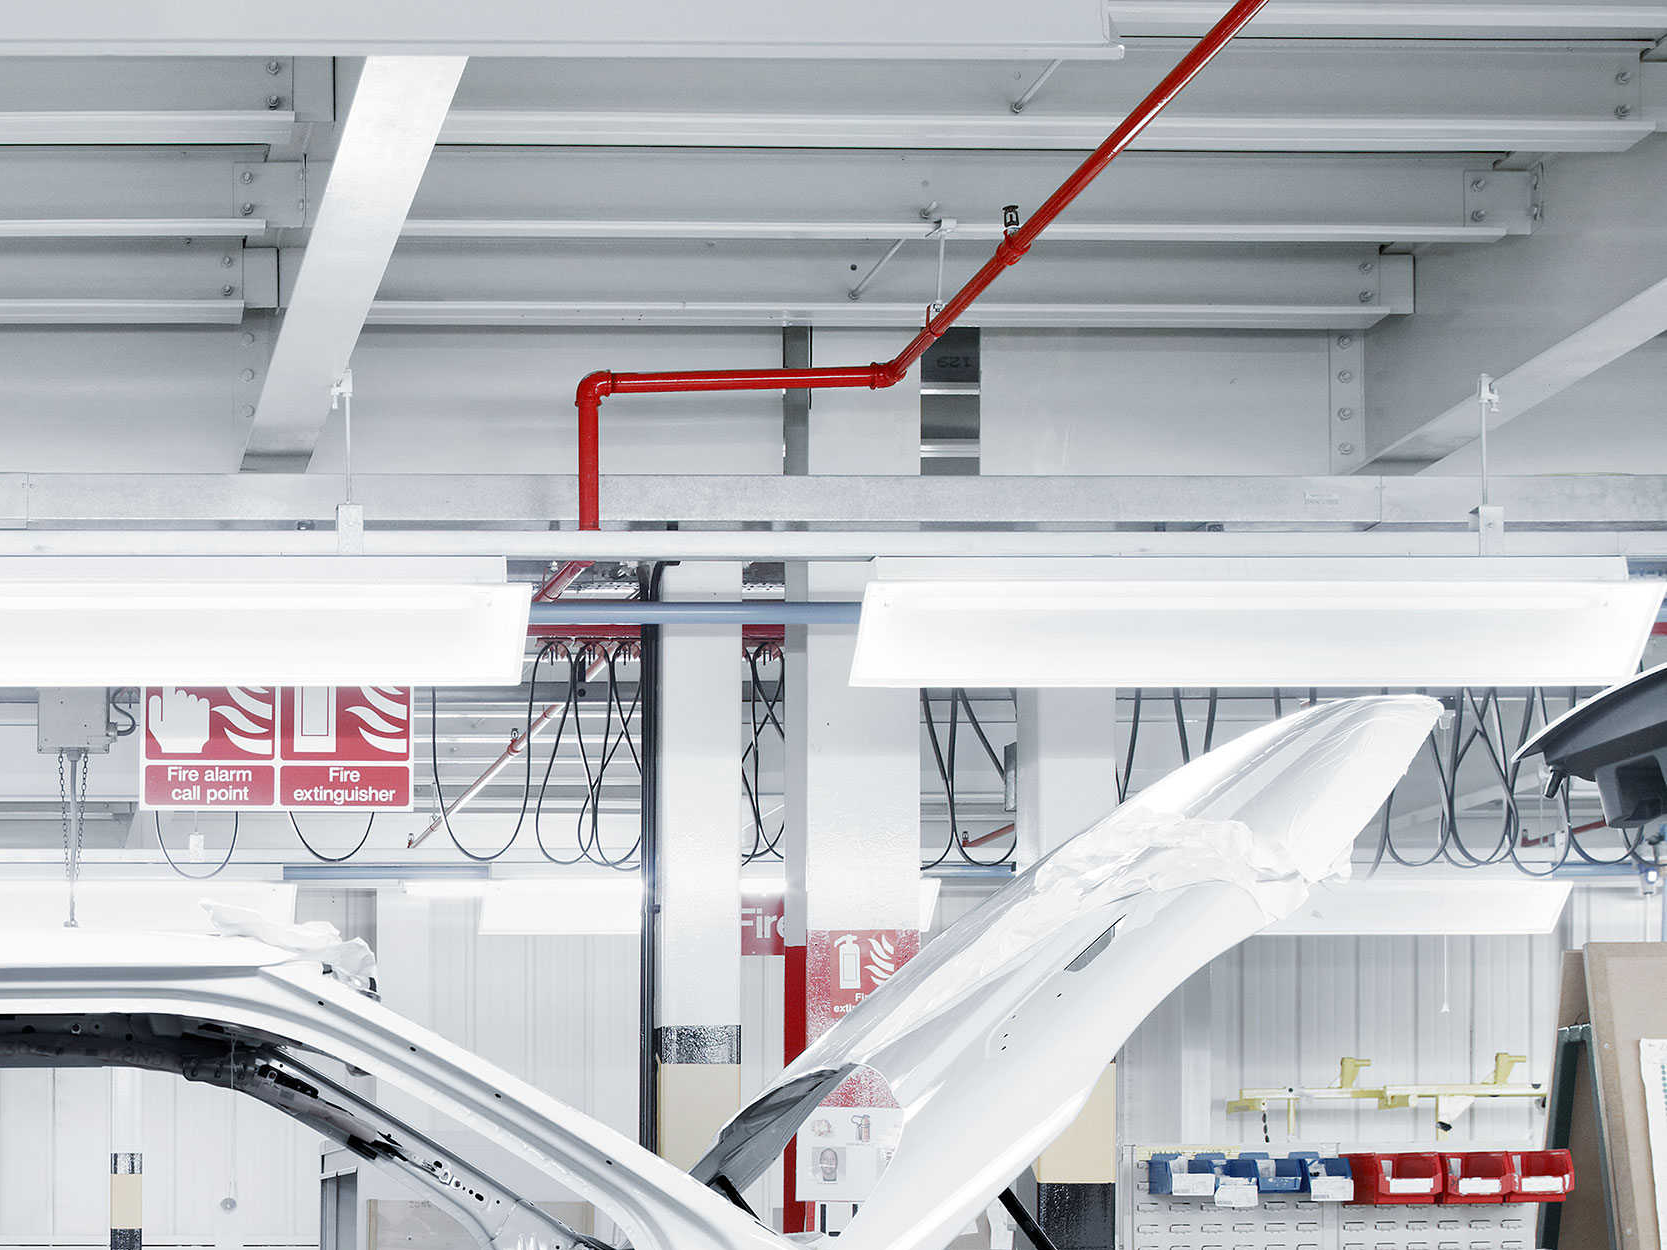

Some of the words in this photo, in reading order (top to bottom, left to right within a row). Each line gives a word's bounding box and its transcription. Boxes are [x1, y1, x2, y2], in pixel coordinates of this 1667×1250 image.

[167, 766, 199, 782] Fire
[203, 766, 252, 782] alarm
[329, 766, 361, 783] Fire
[171, 785, 201, 801] call
[206, 785, 250, 804] point
[293, 785, 396, 804] extinguisher
